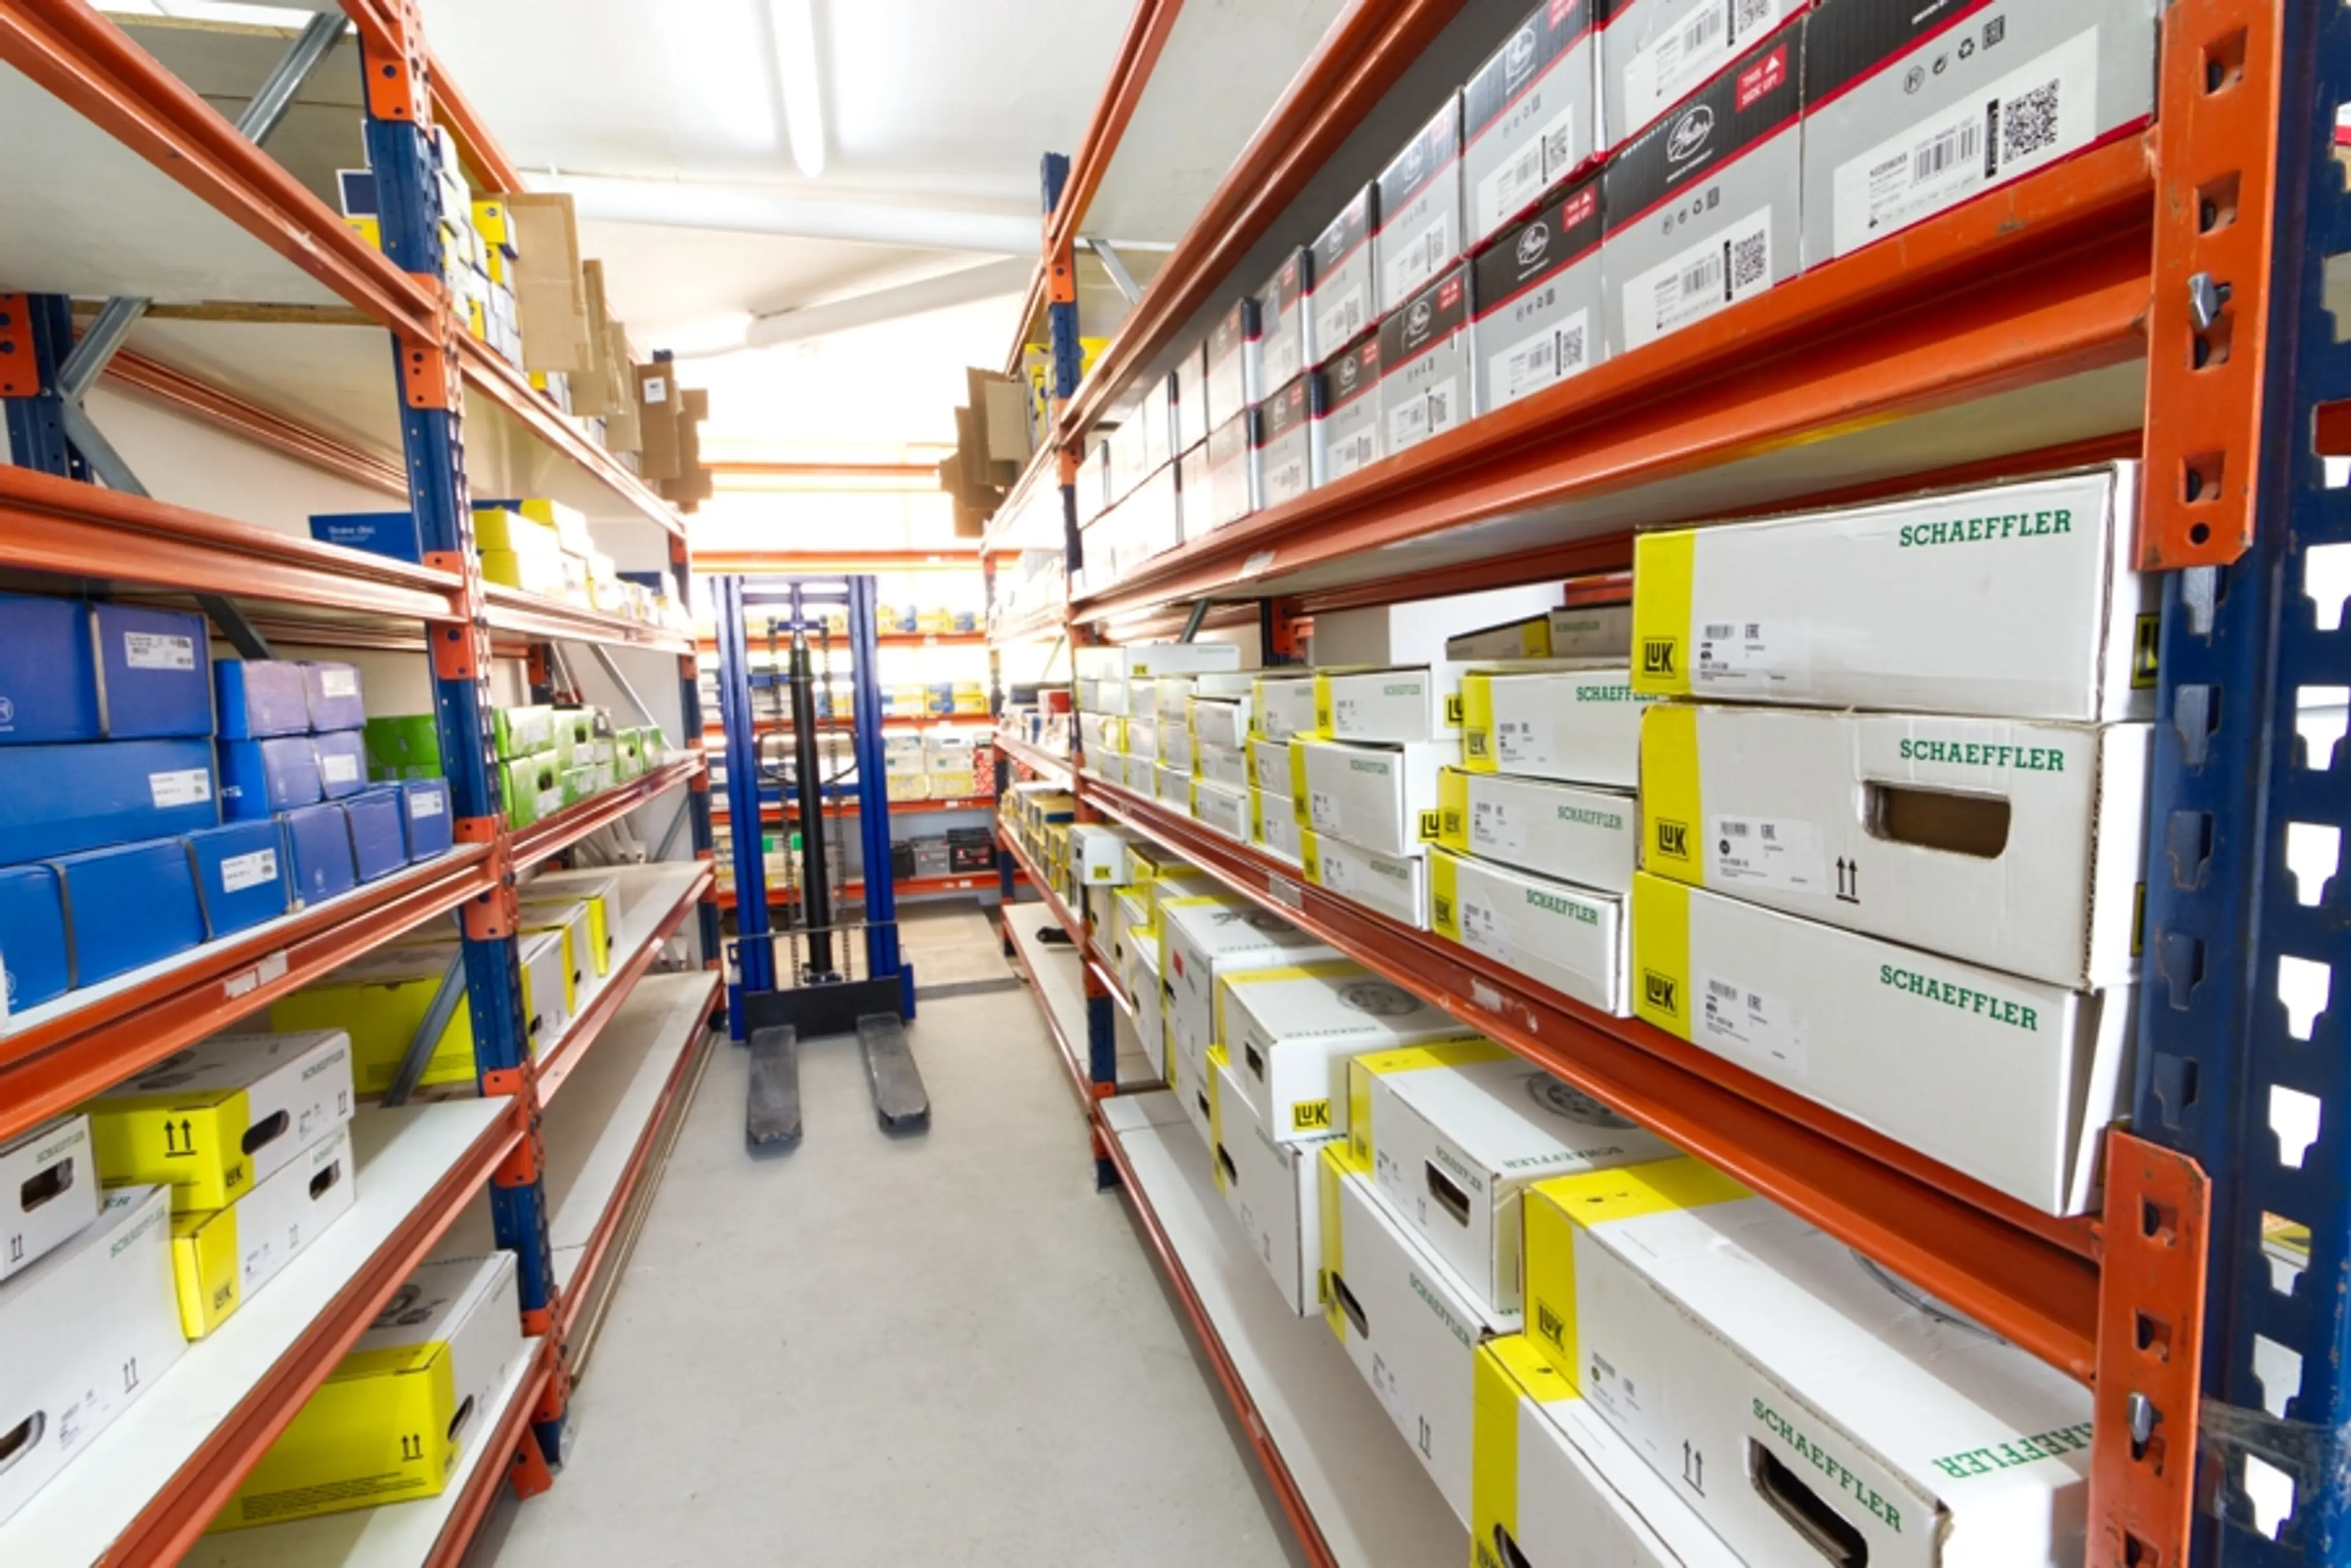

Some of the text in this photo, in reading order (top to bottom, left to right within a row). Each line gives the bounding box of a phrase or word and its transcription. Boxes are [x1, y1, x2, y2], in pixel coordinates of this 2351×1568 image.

[1899, 510, 2071, 546] SCHAEFFLER
[1900, 739, 2064, 771] SCHAEFFLER
[1557, 805, 1624, 830] SCHAEFFLER
[1526, 889, 1598, 926] SCHAEFFLER
[1880, 964, 2038, 1031] SCHAEFFLER
[1752, 1398, 1902, 1533] SCHAEFFLER
